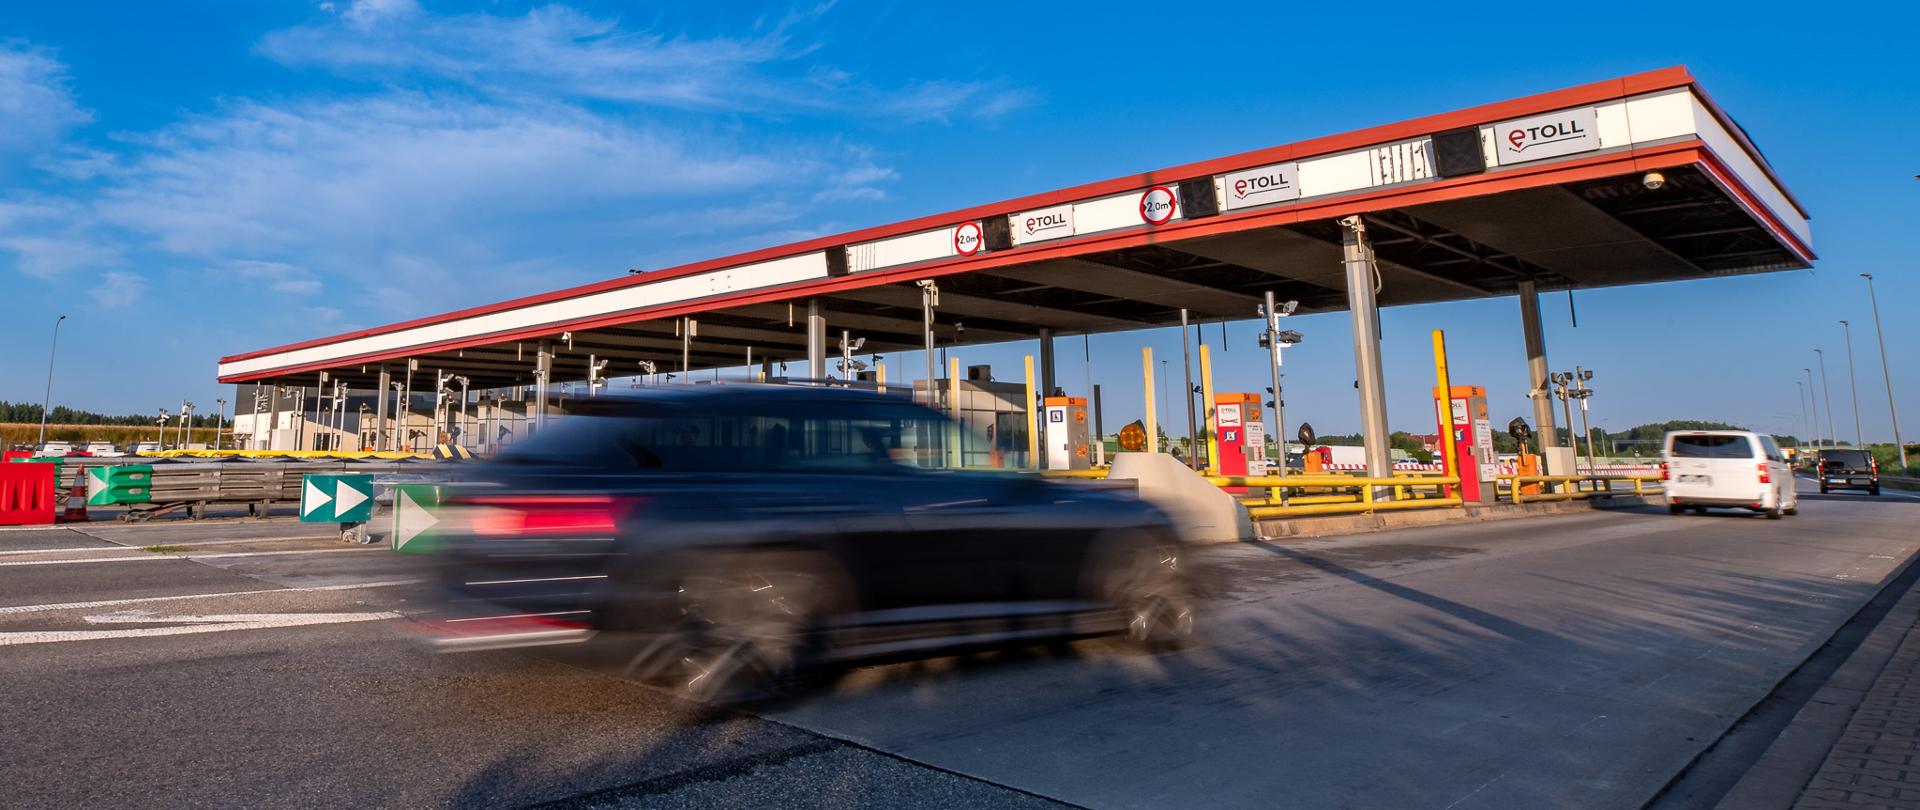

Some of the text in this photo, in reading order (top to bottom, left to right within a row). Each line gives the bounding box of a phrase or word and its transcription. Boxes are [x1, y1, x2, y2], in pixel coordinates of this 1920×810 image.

[1508, 120, 1584, 148] eTOLL
[1234, 173, 1289, 195] eTOLL
[1146, 202, 1169, 213] 2.0m
[1026, 213, 1066, 231] eTOLL
[959, 235, 977, 244] 2.0m
